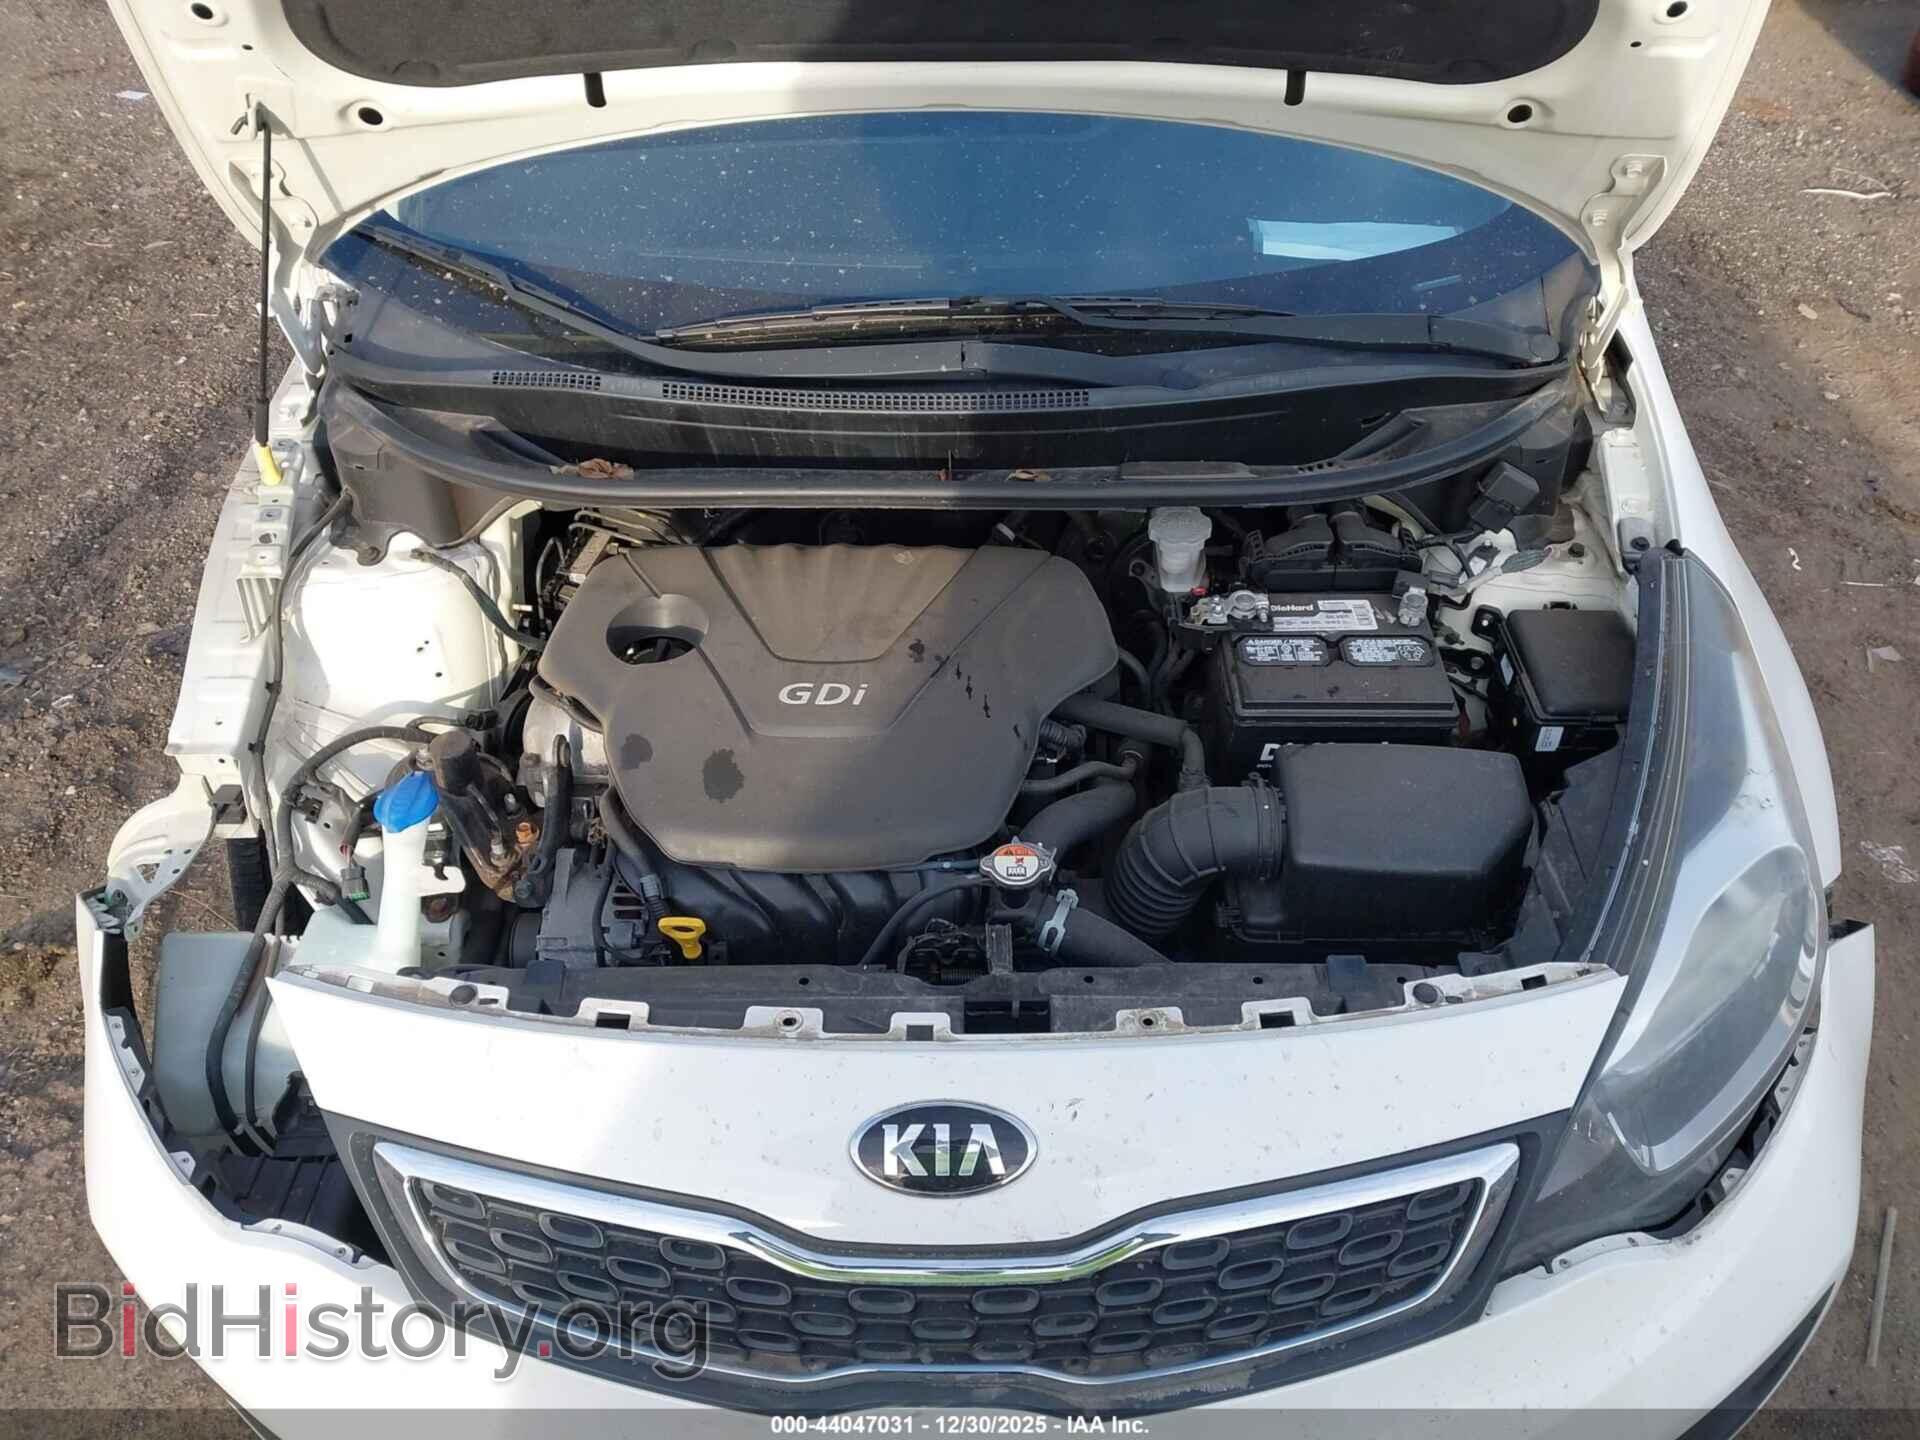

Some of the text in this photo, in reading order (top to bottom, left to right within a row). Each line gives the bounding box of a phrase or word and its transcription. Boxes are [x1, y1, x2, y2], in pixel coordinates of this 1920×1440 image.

[1270, 604, 1314, 612] DieHard
[778, 683, 868, 705] GDi
[882, 1123, 1006, 1176] KIA
